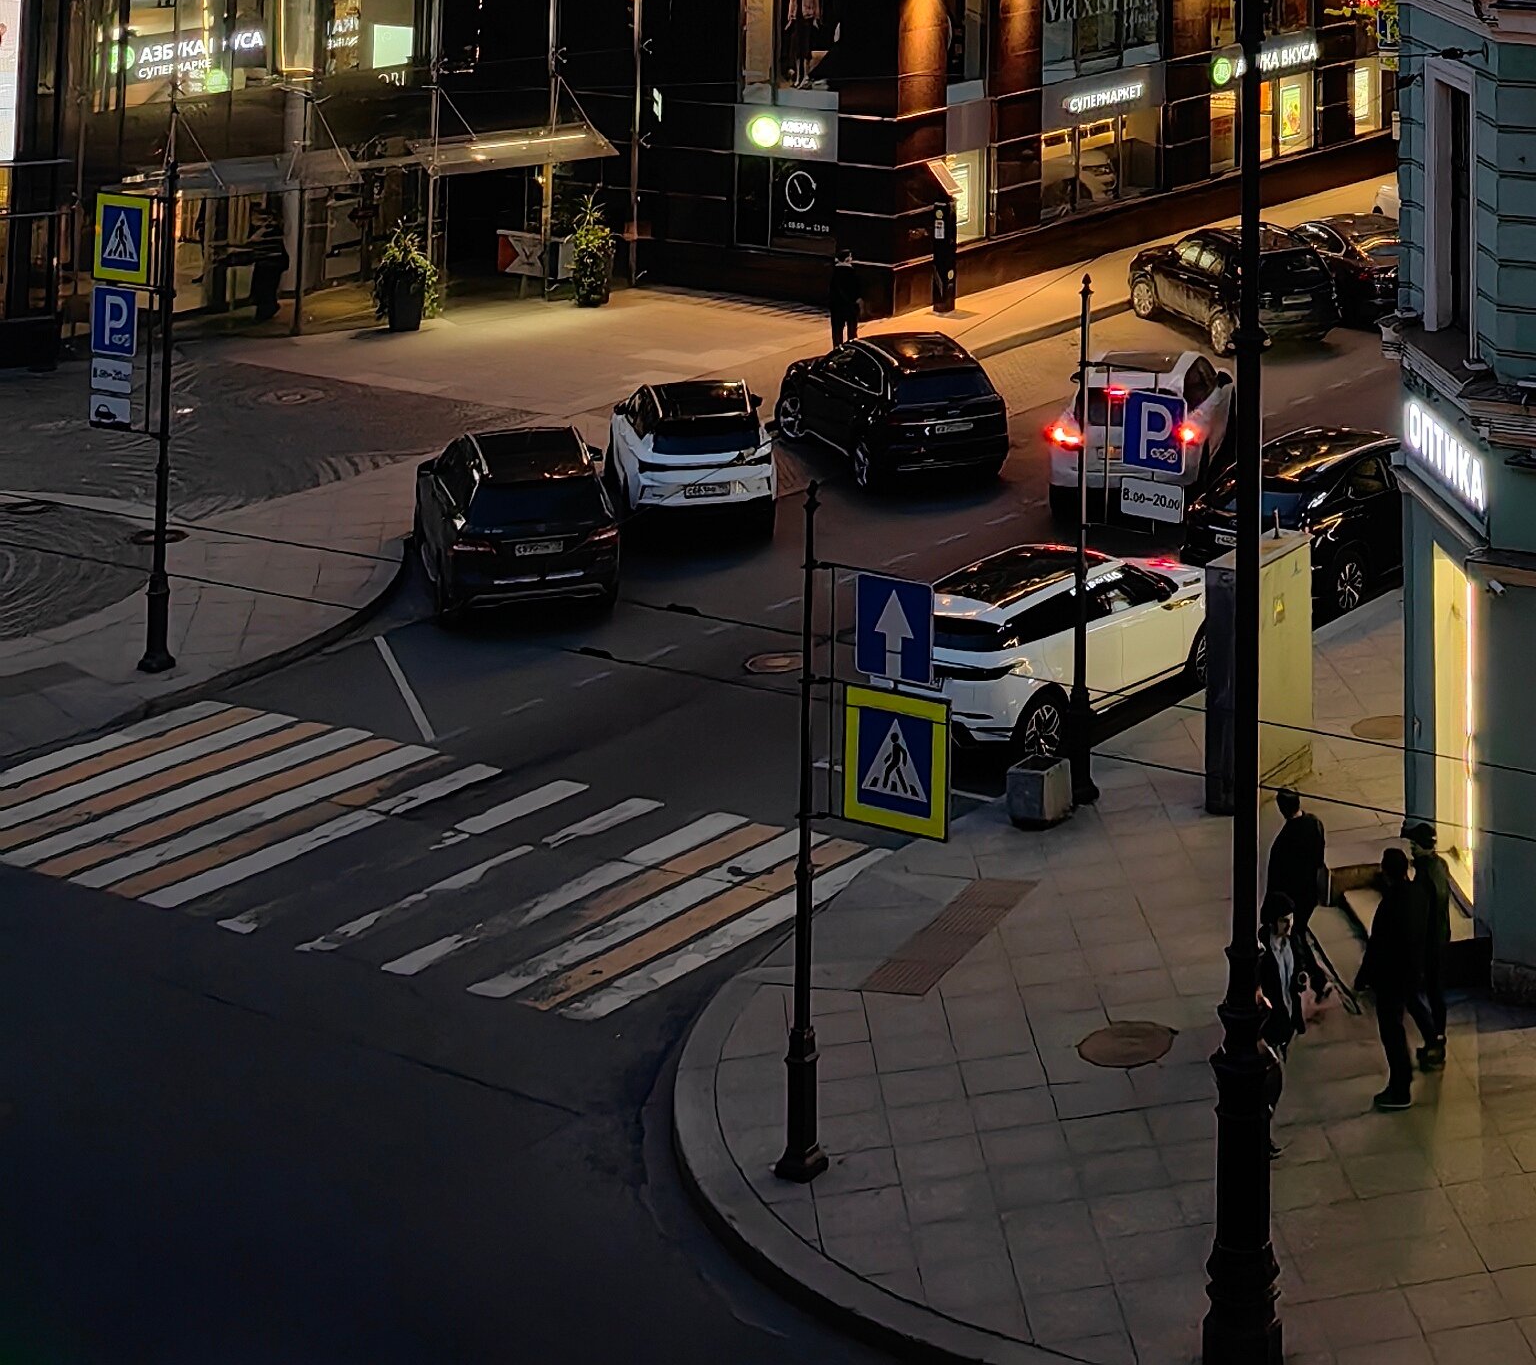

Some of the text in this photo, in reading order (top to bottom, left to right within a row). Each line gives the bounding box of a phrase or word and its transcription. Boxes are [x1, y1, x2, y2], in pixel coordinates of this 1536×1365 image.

[1281, 43, 1318, 67] ВКУСА
[1068, 84, 1143, 114] СУПЕРМАРКЕТ
[104, 294, 128, 346] P
[1139, 401, 1173, 460] P
[1409, 403, 1484, 512] ОПТИКА
